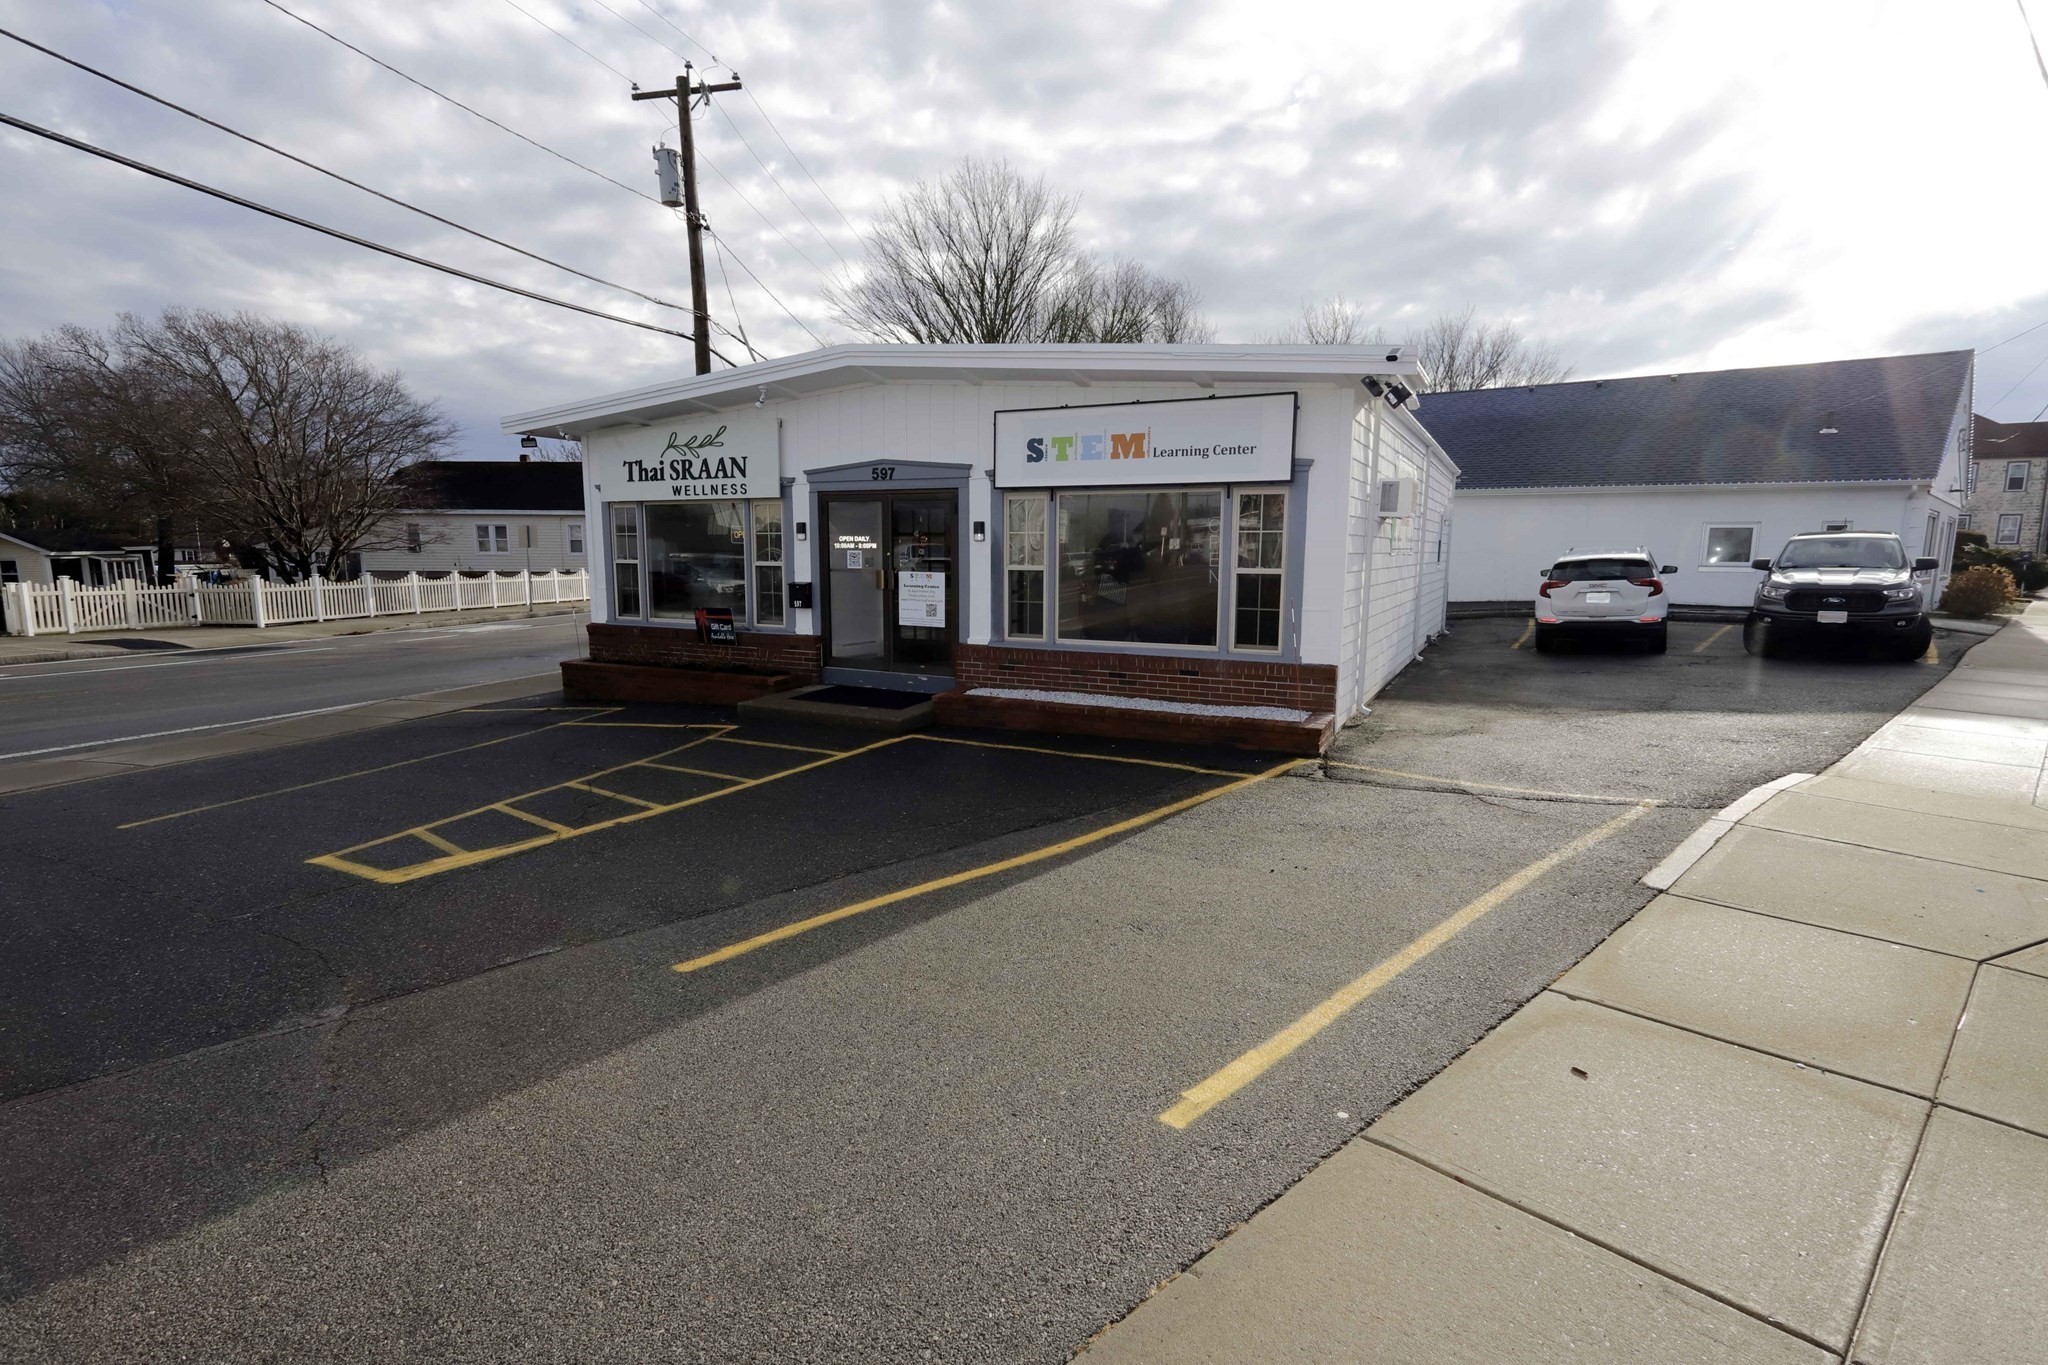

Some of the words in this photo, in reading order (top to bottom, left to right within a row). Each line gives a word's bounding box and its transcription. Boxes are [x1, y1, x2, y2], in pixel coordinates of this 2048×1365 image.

[1026, 432, 1146, 463] STEM
[1153, 445, 1209, 460] Learning
[1212, 443, 1257, 456] Center
[623, 459, 666, 482] Thai
[669, 456, 748, 481] SRAAN
[871, 467, 896, 481] 597
[672, 483, 748, 497] WELLNESS
[1209, 519, 1220, 583] OPEN
[719, 623, 732, 631] Card
